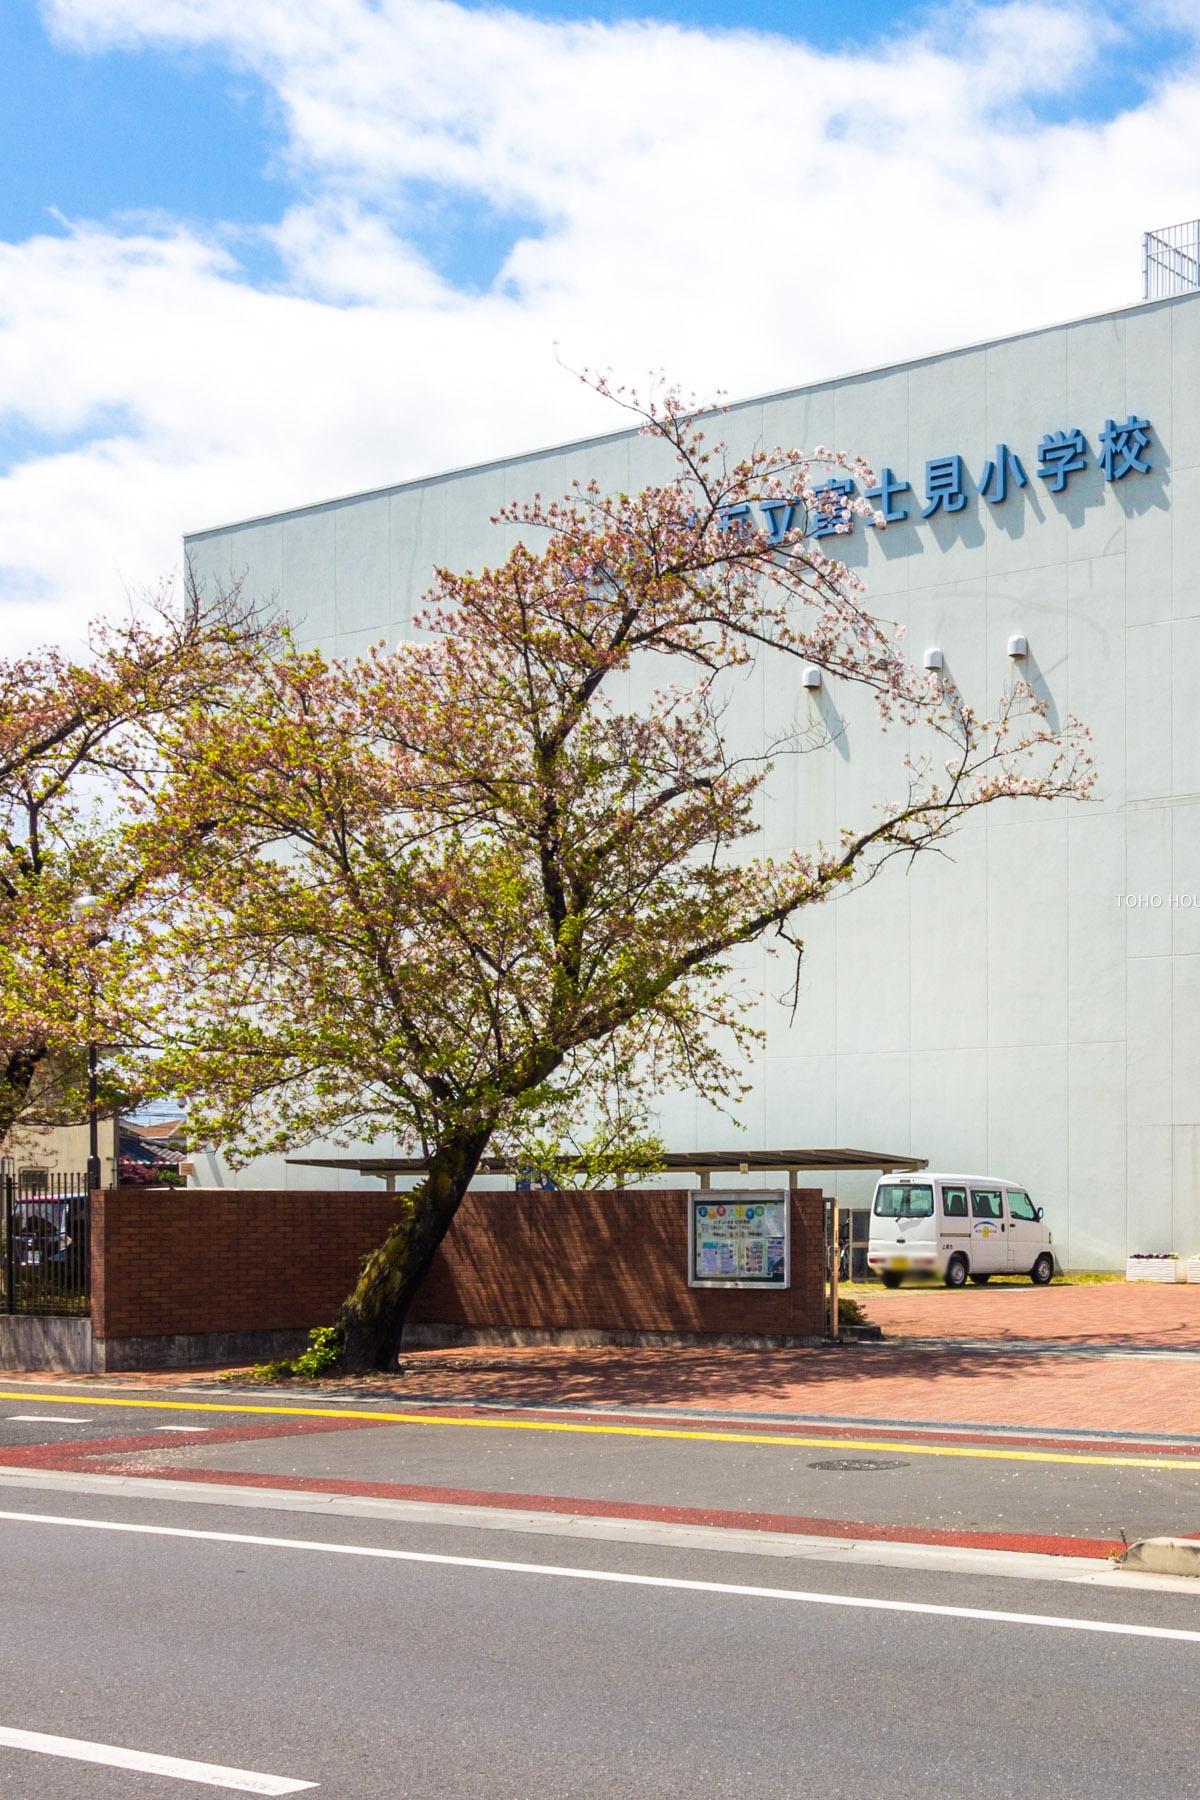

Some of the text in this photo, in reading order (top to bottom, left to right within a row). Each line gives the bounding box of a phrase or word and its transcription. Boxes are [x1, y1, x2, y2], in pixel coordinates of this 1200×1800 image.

[626, 415, 1151, 572] 市立富士見小学校
